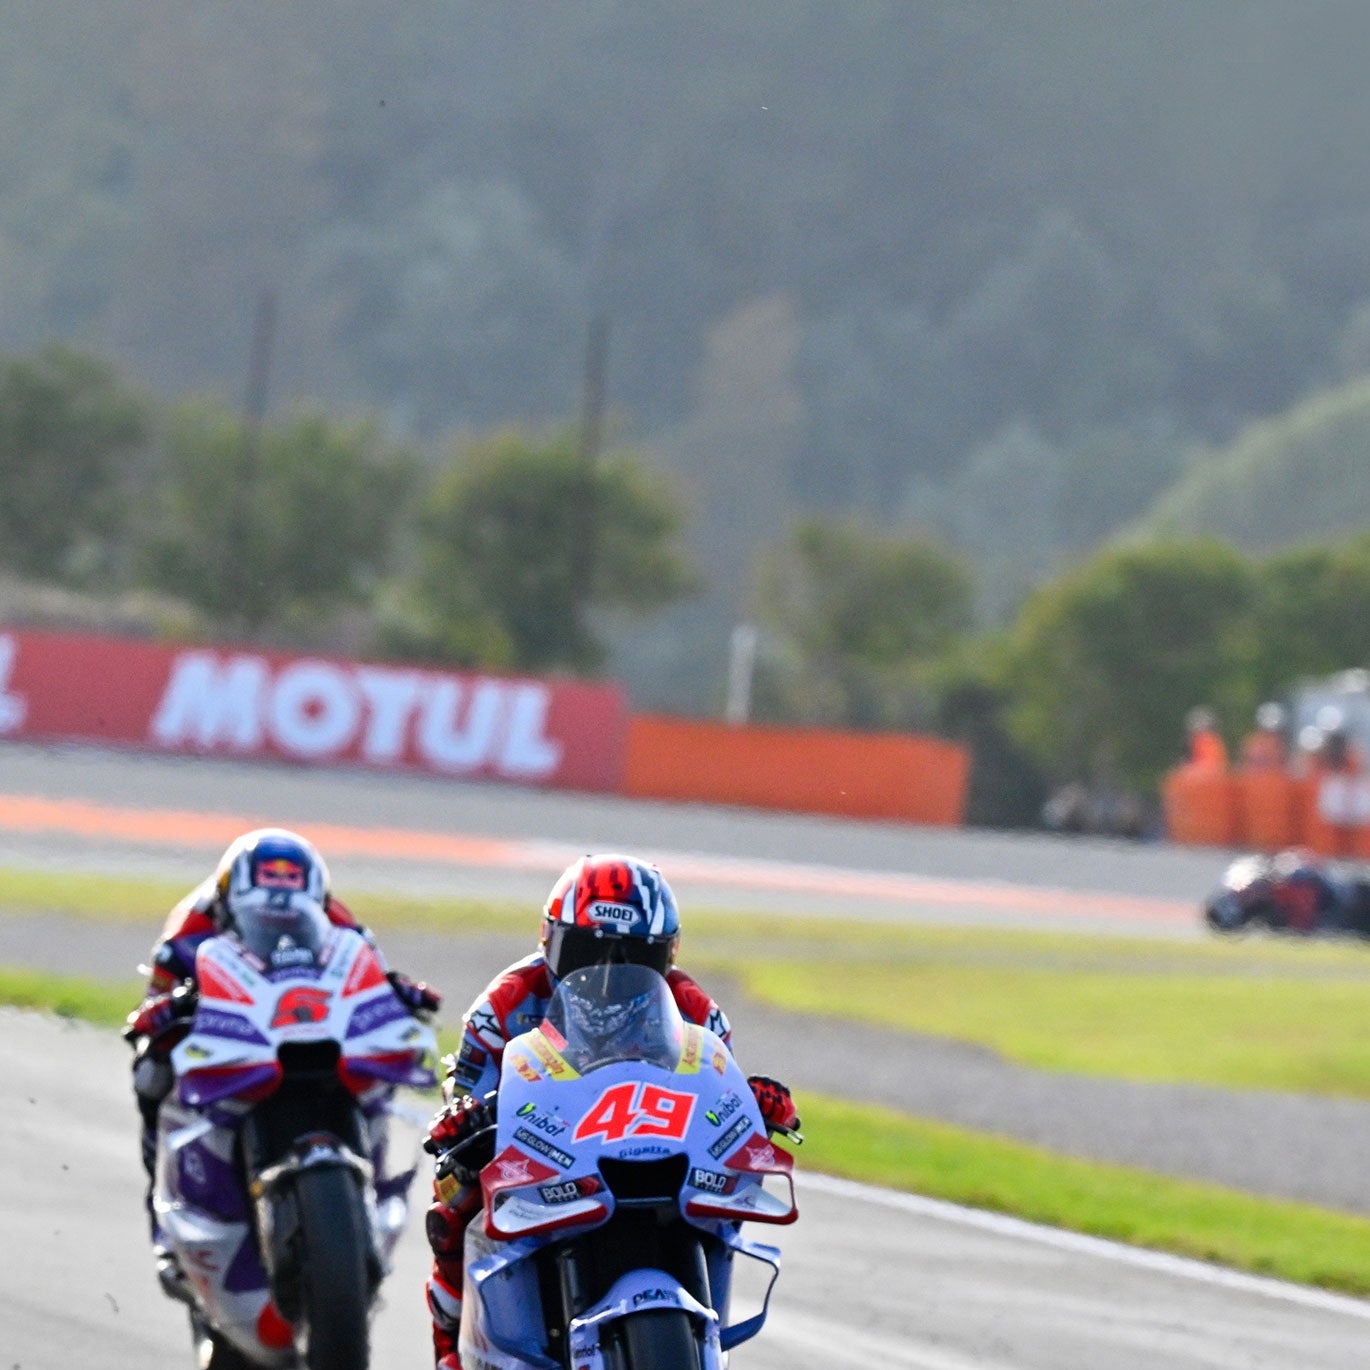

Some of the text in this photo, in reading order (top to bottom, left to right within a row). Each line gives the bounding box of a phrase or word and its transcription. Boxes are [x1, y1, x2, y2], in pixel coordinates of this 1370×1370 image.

[150, 648, 561, 777] MOTUL
[595, 905, 633, 922] SHOEI
[516, 1102, 567, 1137] Unibat
[571, 1080, 699, 1145] 49
[542, 1181, 578, 1200] BOLD
[695, 1169, 728, 1188] BOLD
